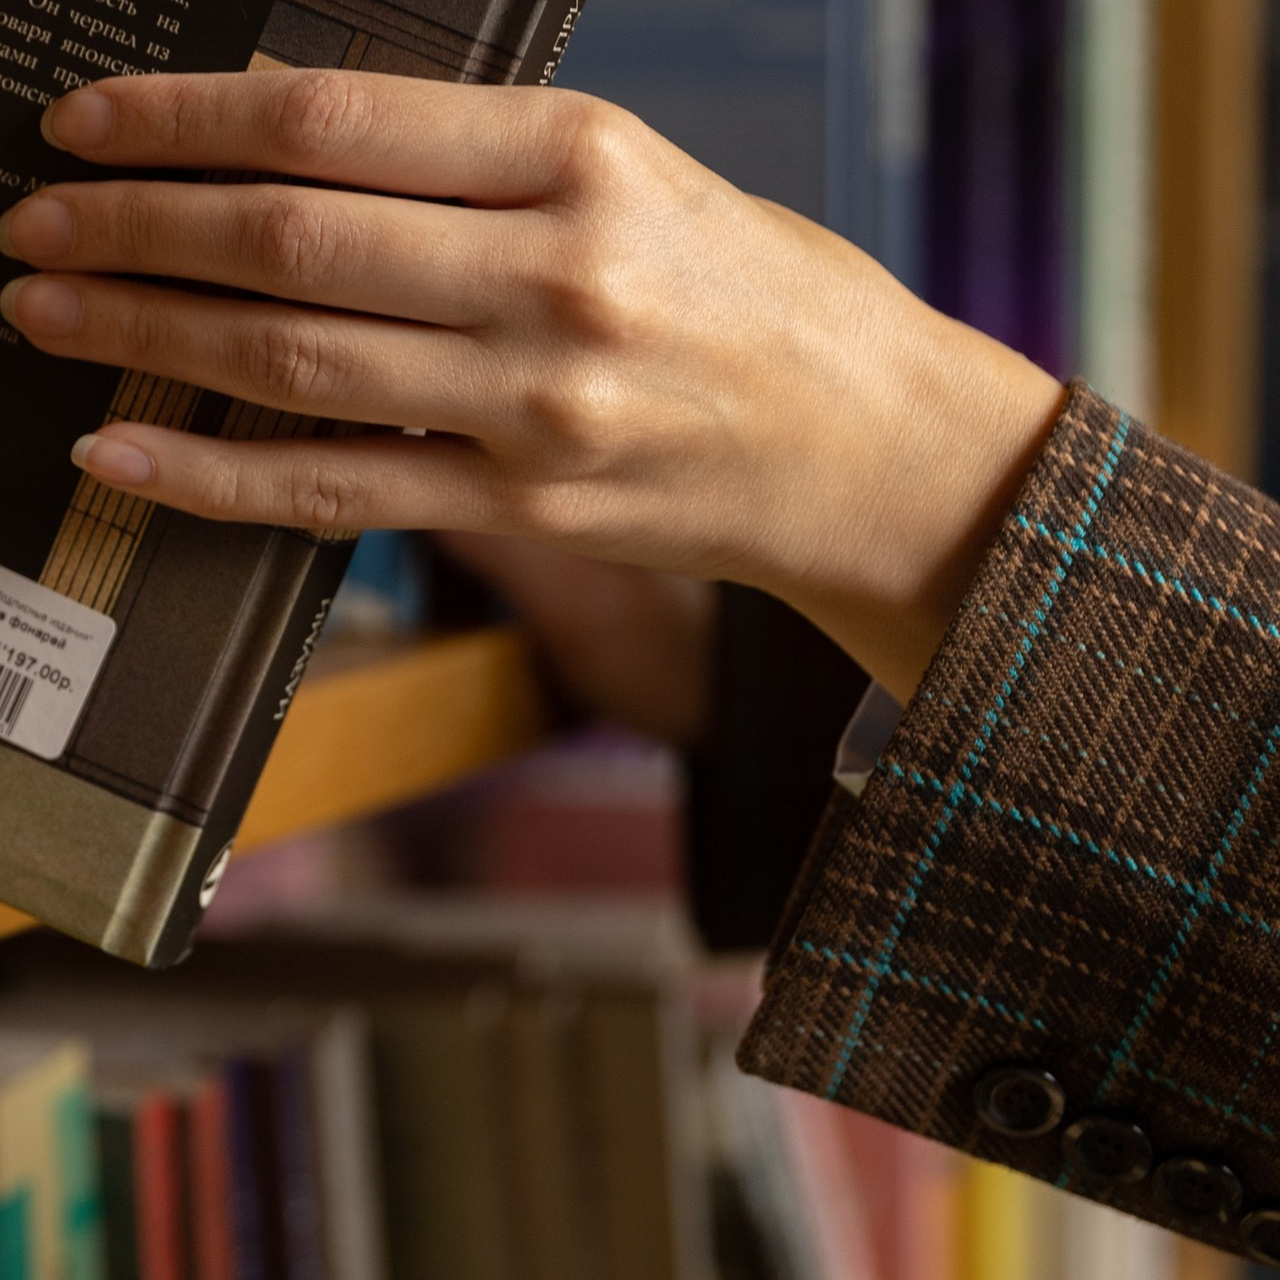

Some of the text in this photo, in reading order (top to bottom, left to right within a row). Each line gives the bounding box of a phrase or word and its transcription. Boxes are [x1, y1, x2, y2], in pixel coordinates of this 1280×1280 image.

[69, 9, 135, 48] черпал
[146, 41, 169, 60] из
[156, 13, 179, 34] на
[60, 38, 160, 76] японско
[7, 614, 67, 651] фонарей
